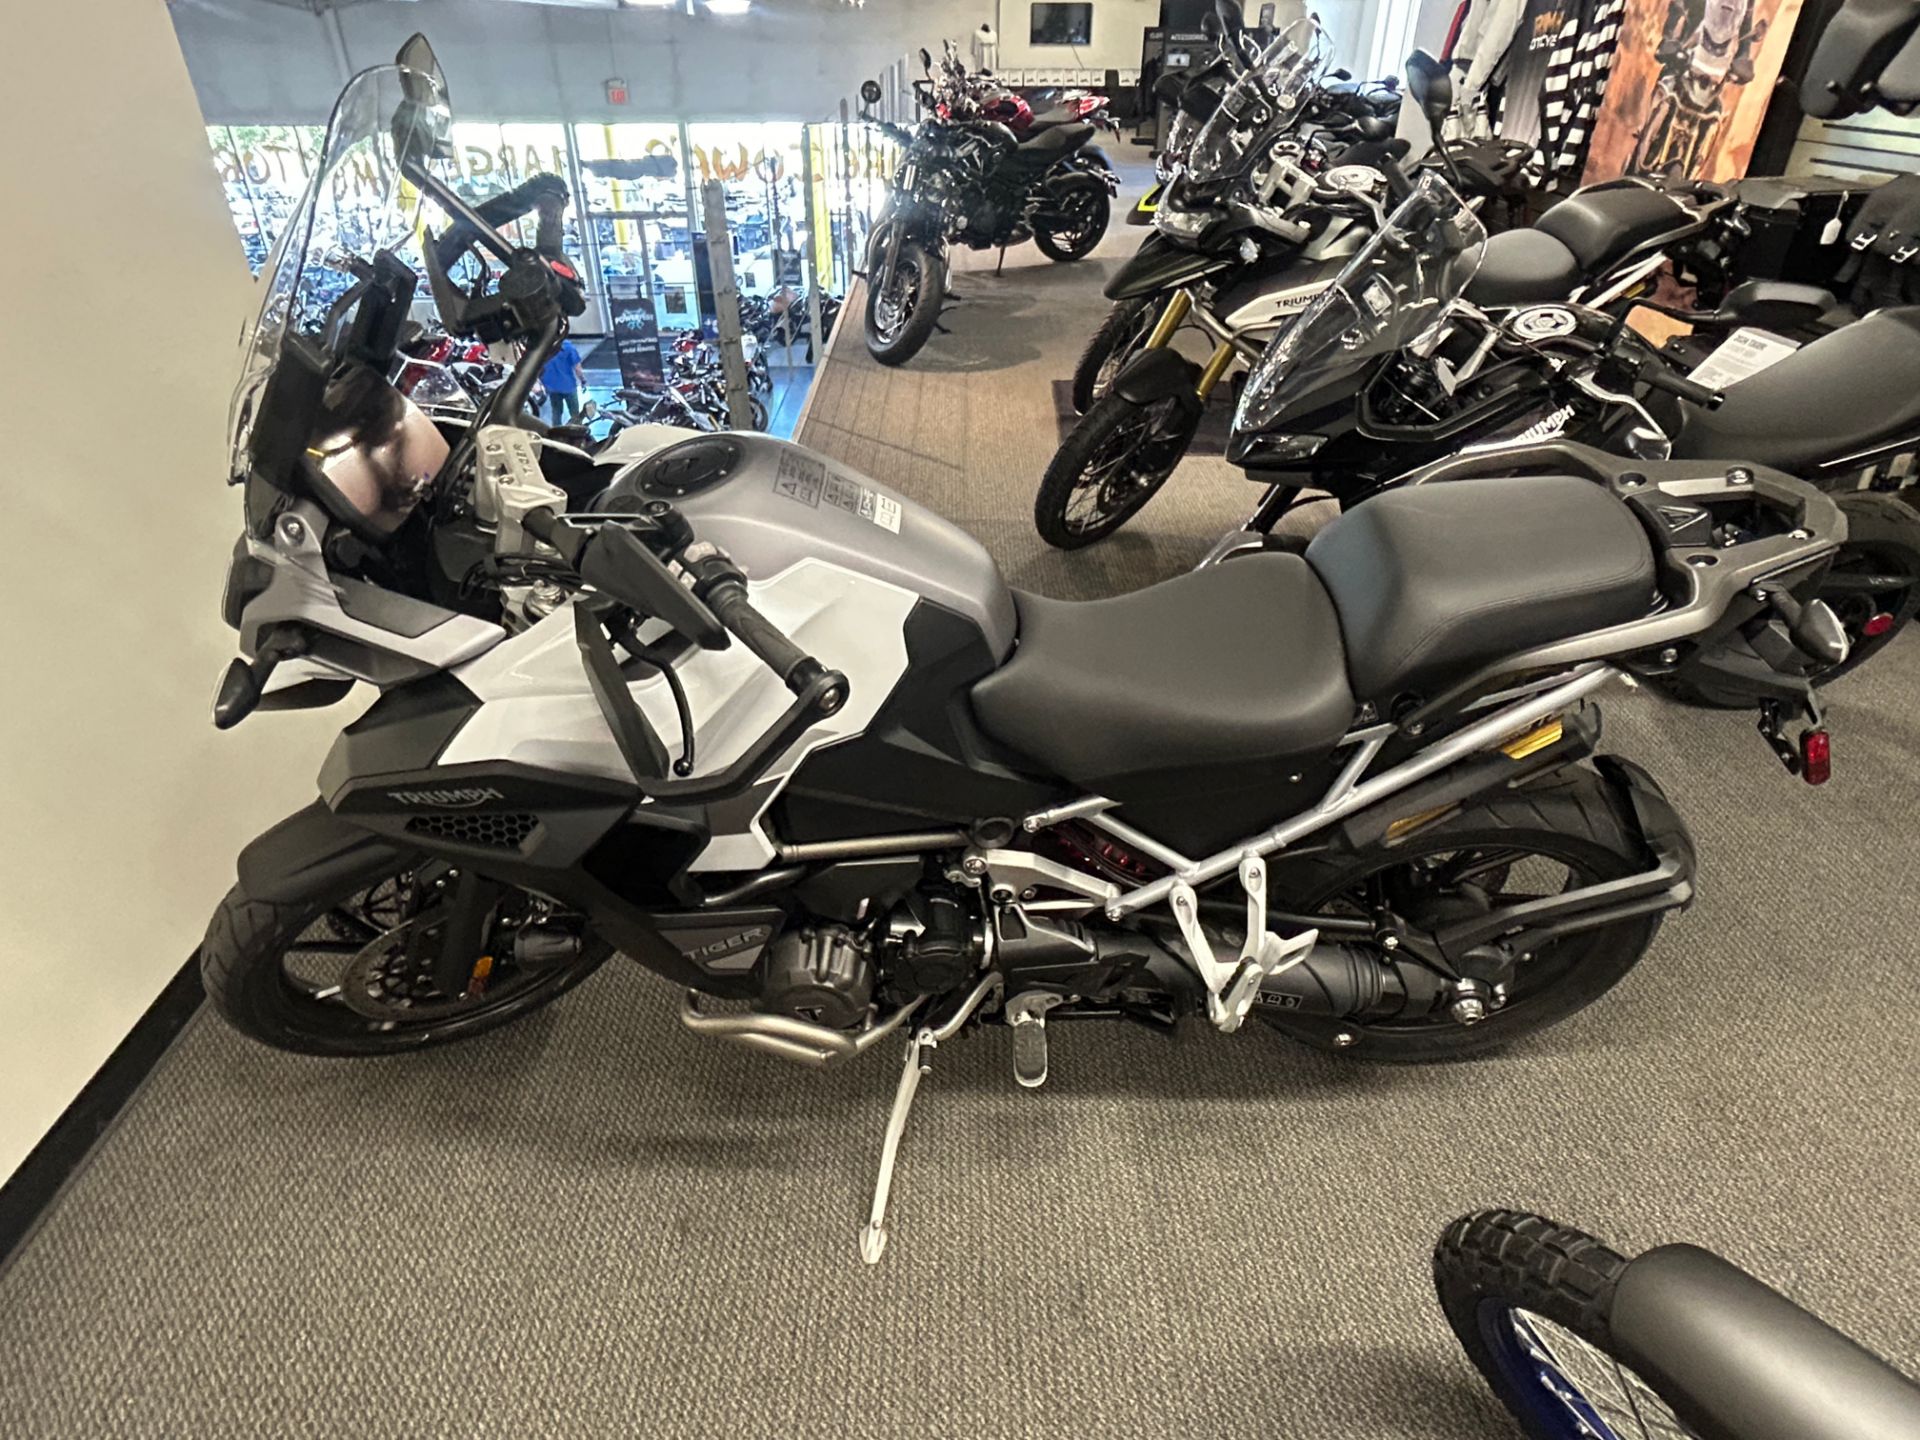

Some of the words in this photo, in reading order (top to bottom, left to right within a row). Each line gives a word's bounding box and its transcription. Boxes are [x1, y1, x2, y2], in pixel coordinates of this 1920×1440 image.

[1275, 293, 1322, 309] TRIUMP
[386, 787, 505, 806] TRIUMPH
[681, 927, 767, 962] TIGER
